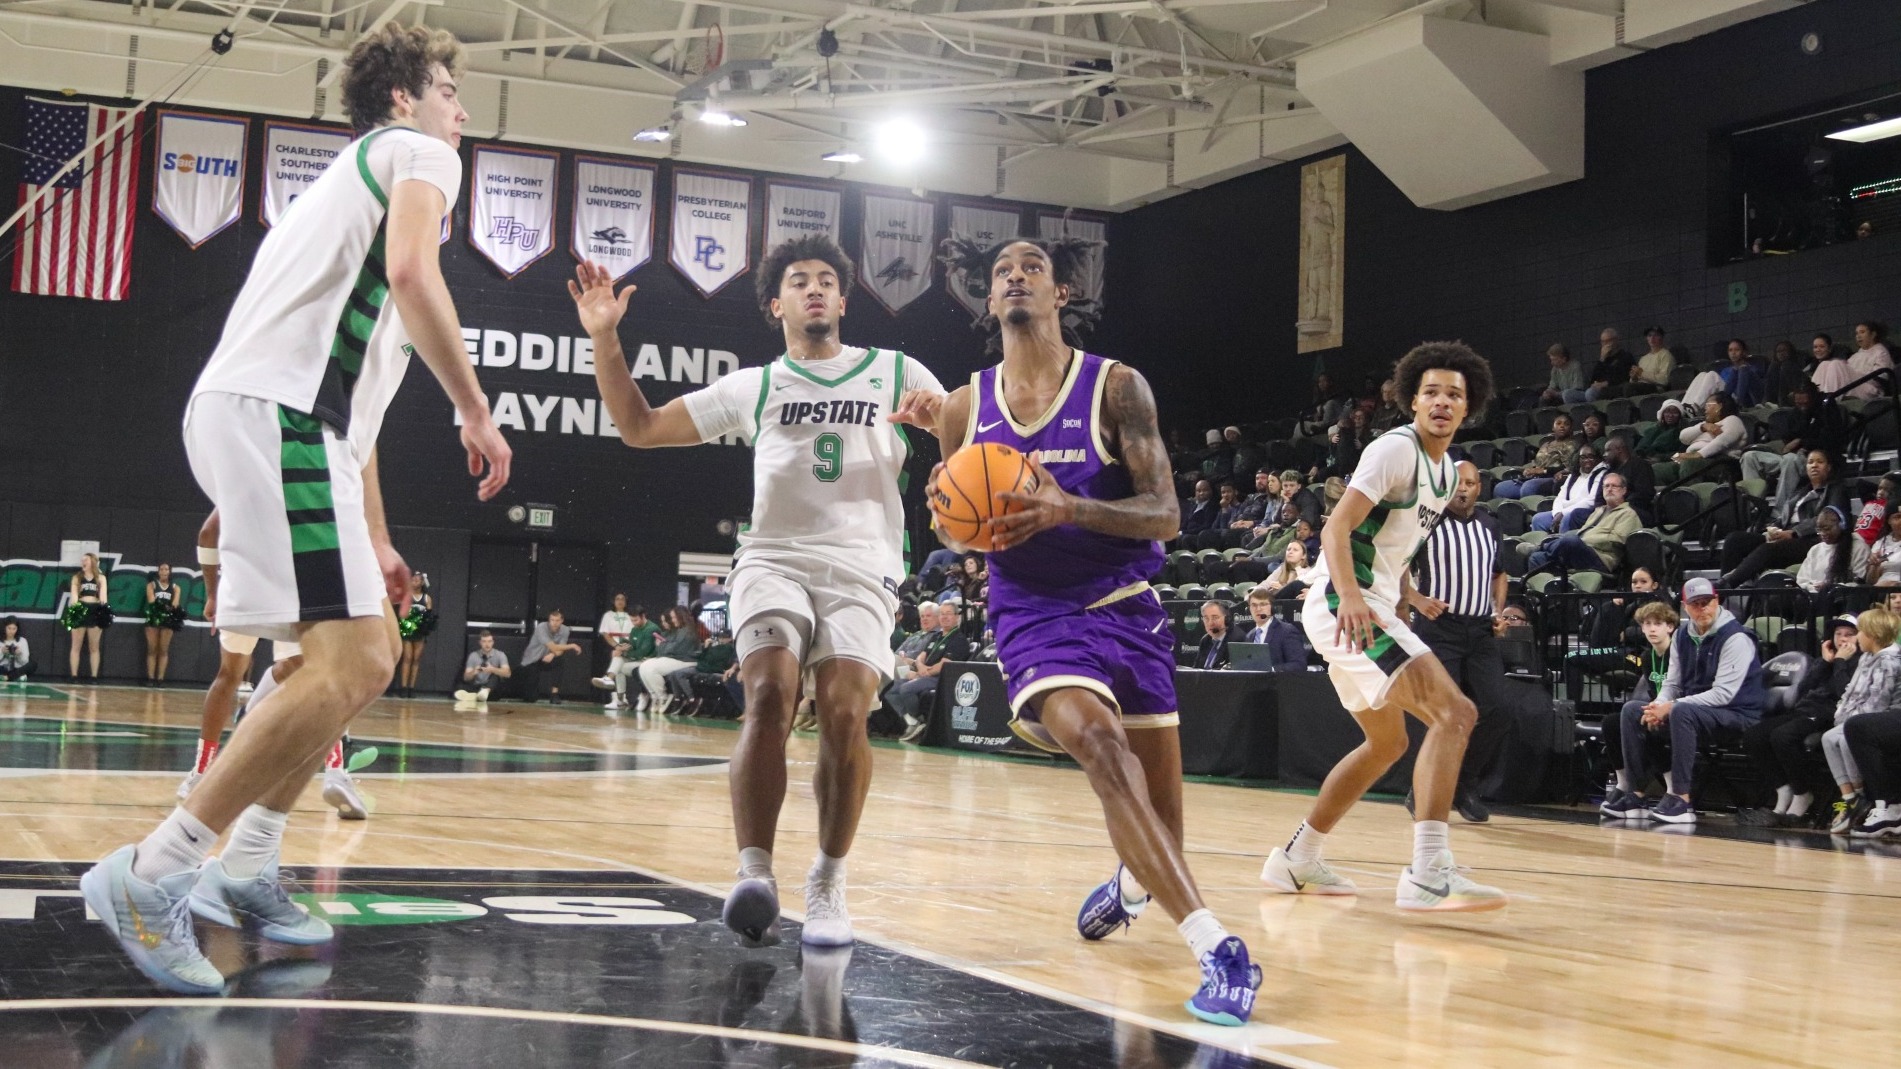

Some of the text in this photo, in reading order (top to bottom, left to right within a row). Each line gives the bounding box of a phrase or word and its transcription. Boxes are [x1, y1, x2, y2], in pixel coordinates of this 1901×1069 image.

[280, 158, 329, 171] SOUTHER
[487, 174, 543, 187] HIGH POINT
[485, 186, 543, 200] UNIVERSITY
[588, 185, 642, 198] LONGWOOD
[586, 197, 642, 211] UNIVERSITY
[677, 195, 747, 210] PRESBYTERIAN
[692, 209, 731, 222] COLLEGE
[783, 206, 826, 220] RADFORD
[777, 219, 831, 232] UNIVERSITY
[888, 220, 907, 229] UNC
[487, 216, 539, 251] HPU
[875, 230, 923, 243] ASHEVILLE
[976, 230, 994, 240] USC
[588, 244, 632, 257] LONGWOOD
[694, 235, 725, 271] PC
[1728, 282, 1749, 314] B
[630, 343, 740, 385] AND
[780, 400, 879, 427] UPSTATE
[813, 432, 843, 482] 9
[535, 511, 550, 524] EXIT
[961, 680, 975, 692] FOX
[959, 734, 975, 743] HOME
[974, 736, 984, 744] OF
[984, 737, 995, 745] THE
